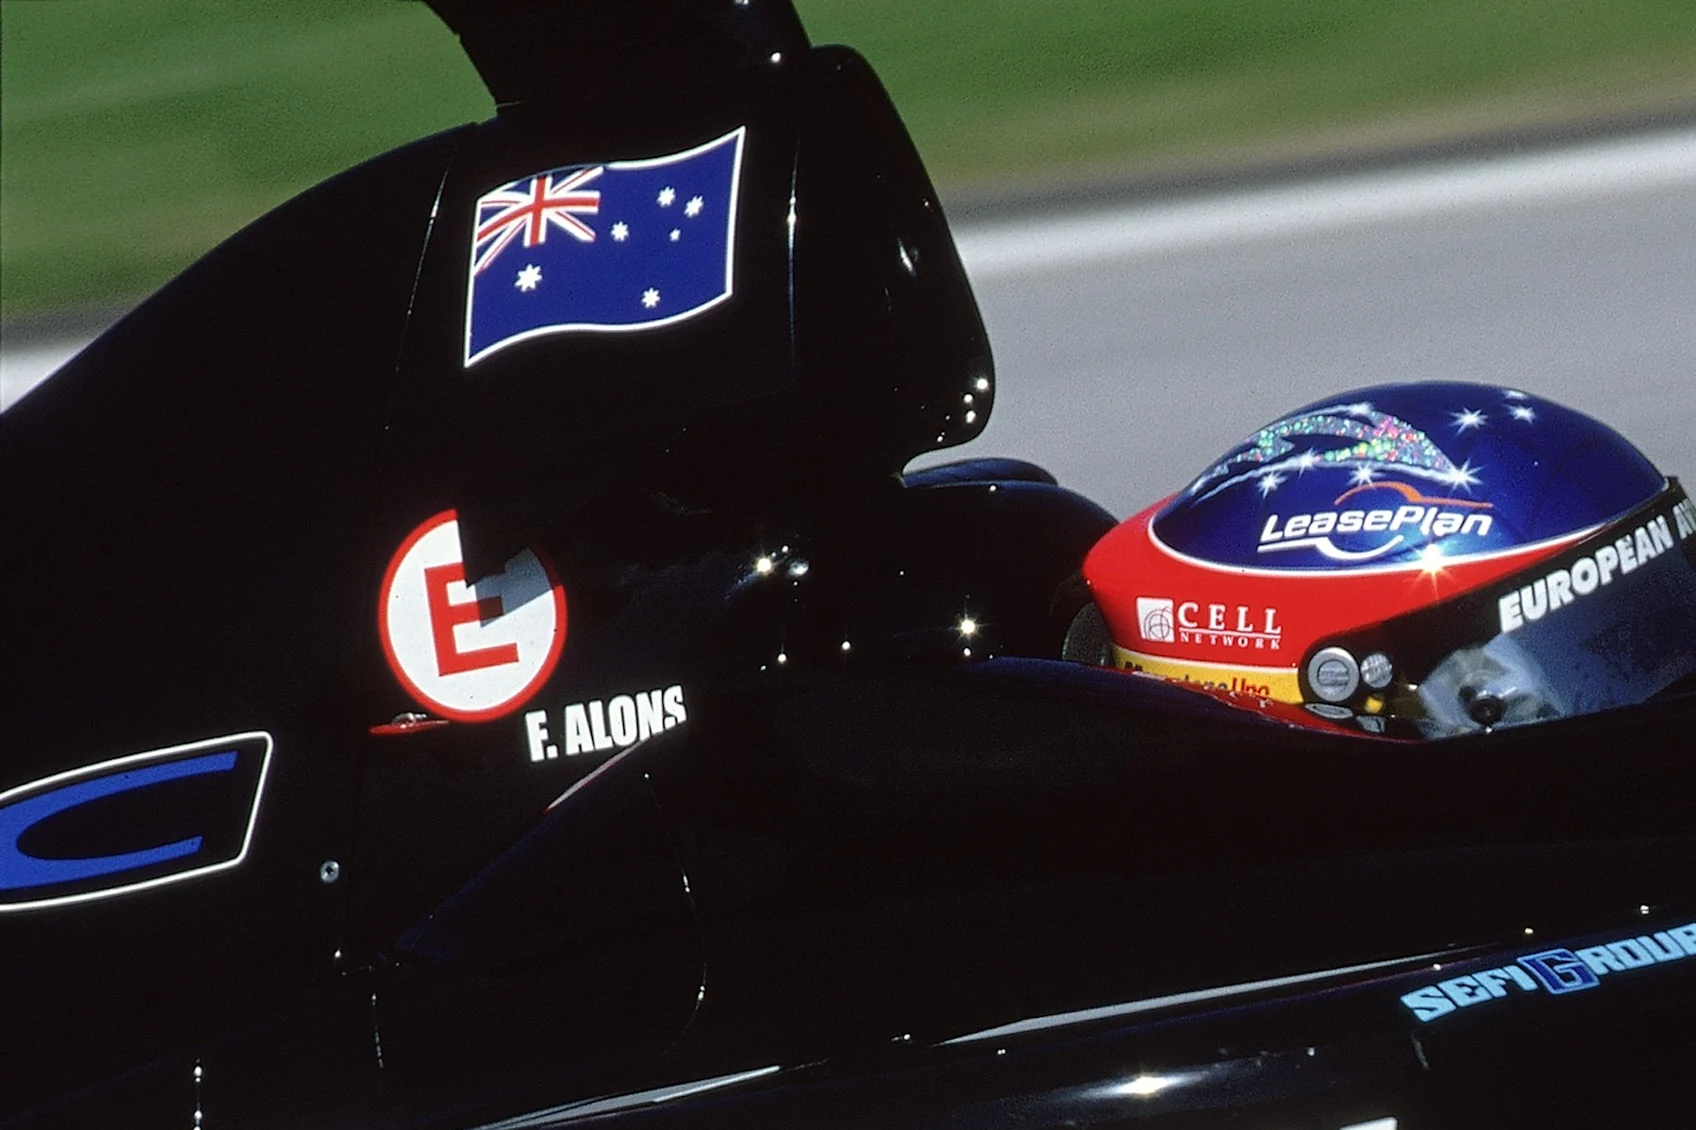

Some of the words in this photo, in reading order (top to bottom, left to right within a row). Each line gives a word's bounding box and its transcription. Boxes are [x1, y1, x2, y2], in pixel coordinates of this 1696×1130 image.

[1258, 505, 1493, 550] LeasePlan
[1499, 515, 1674, 632] EUROPEAN
[1177, 602, 1282, 634] CELL
[1180, 632, 1281, 650] NETWORK
[525, 709, 558, 762] F.
